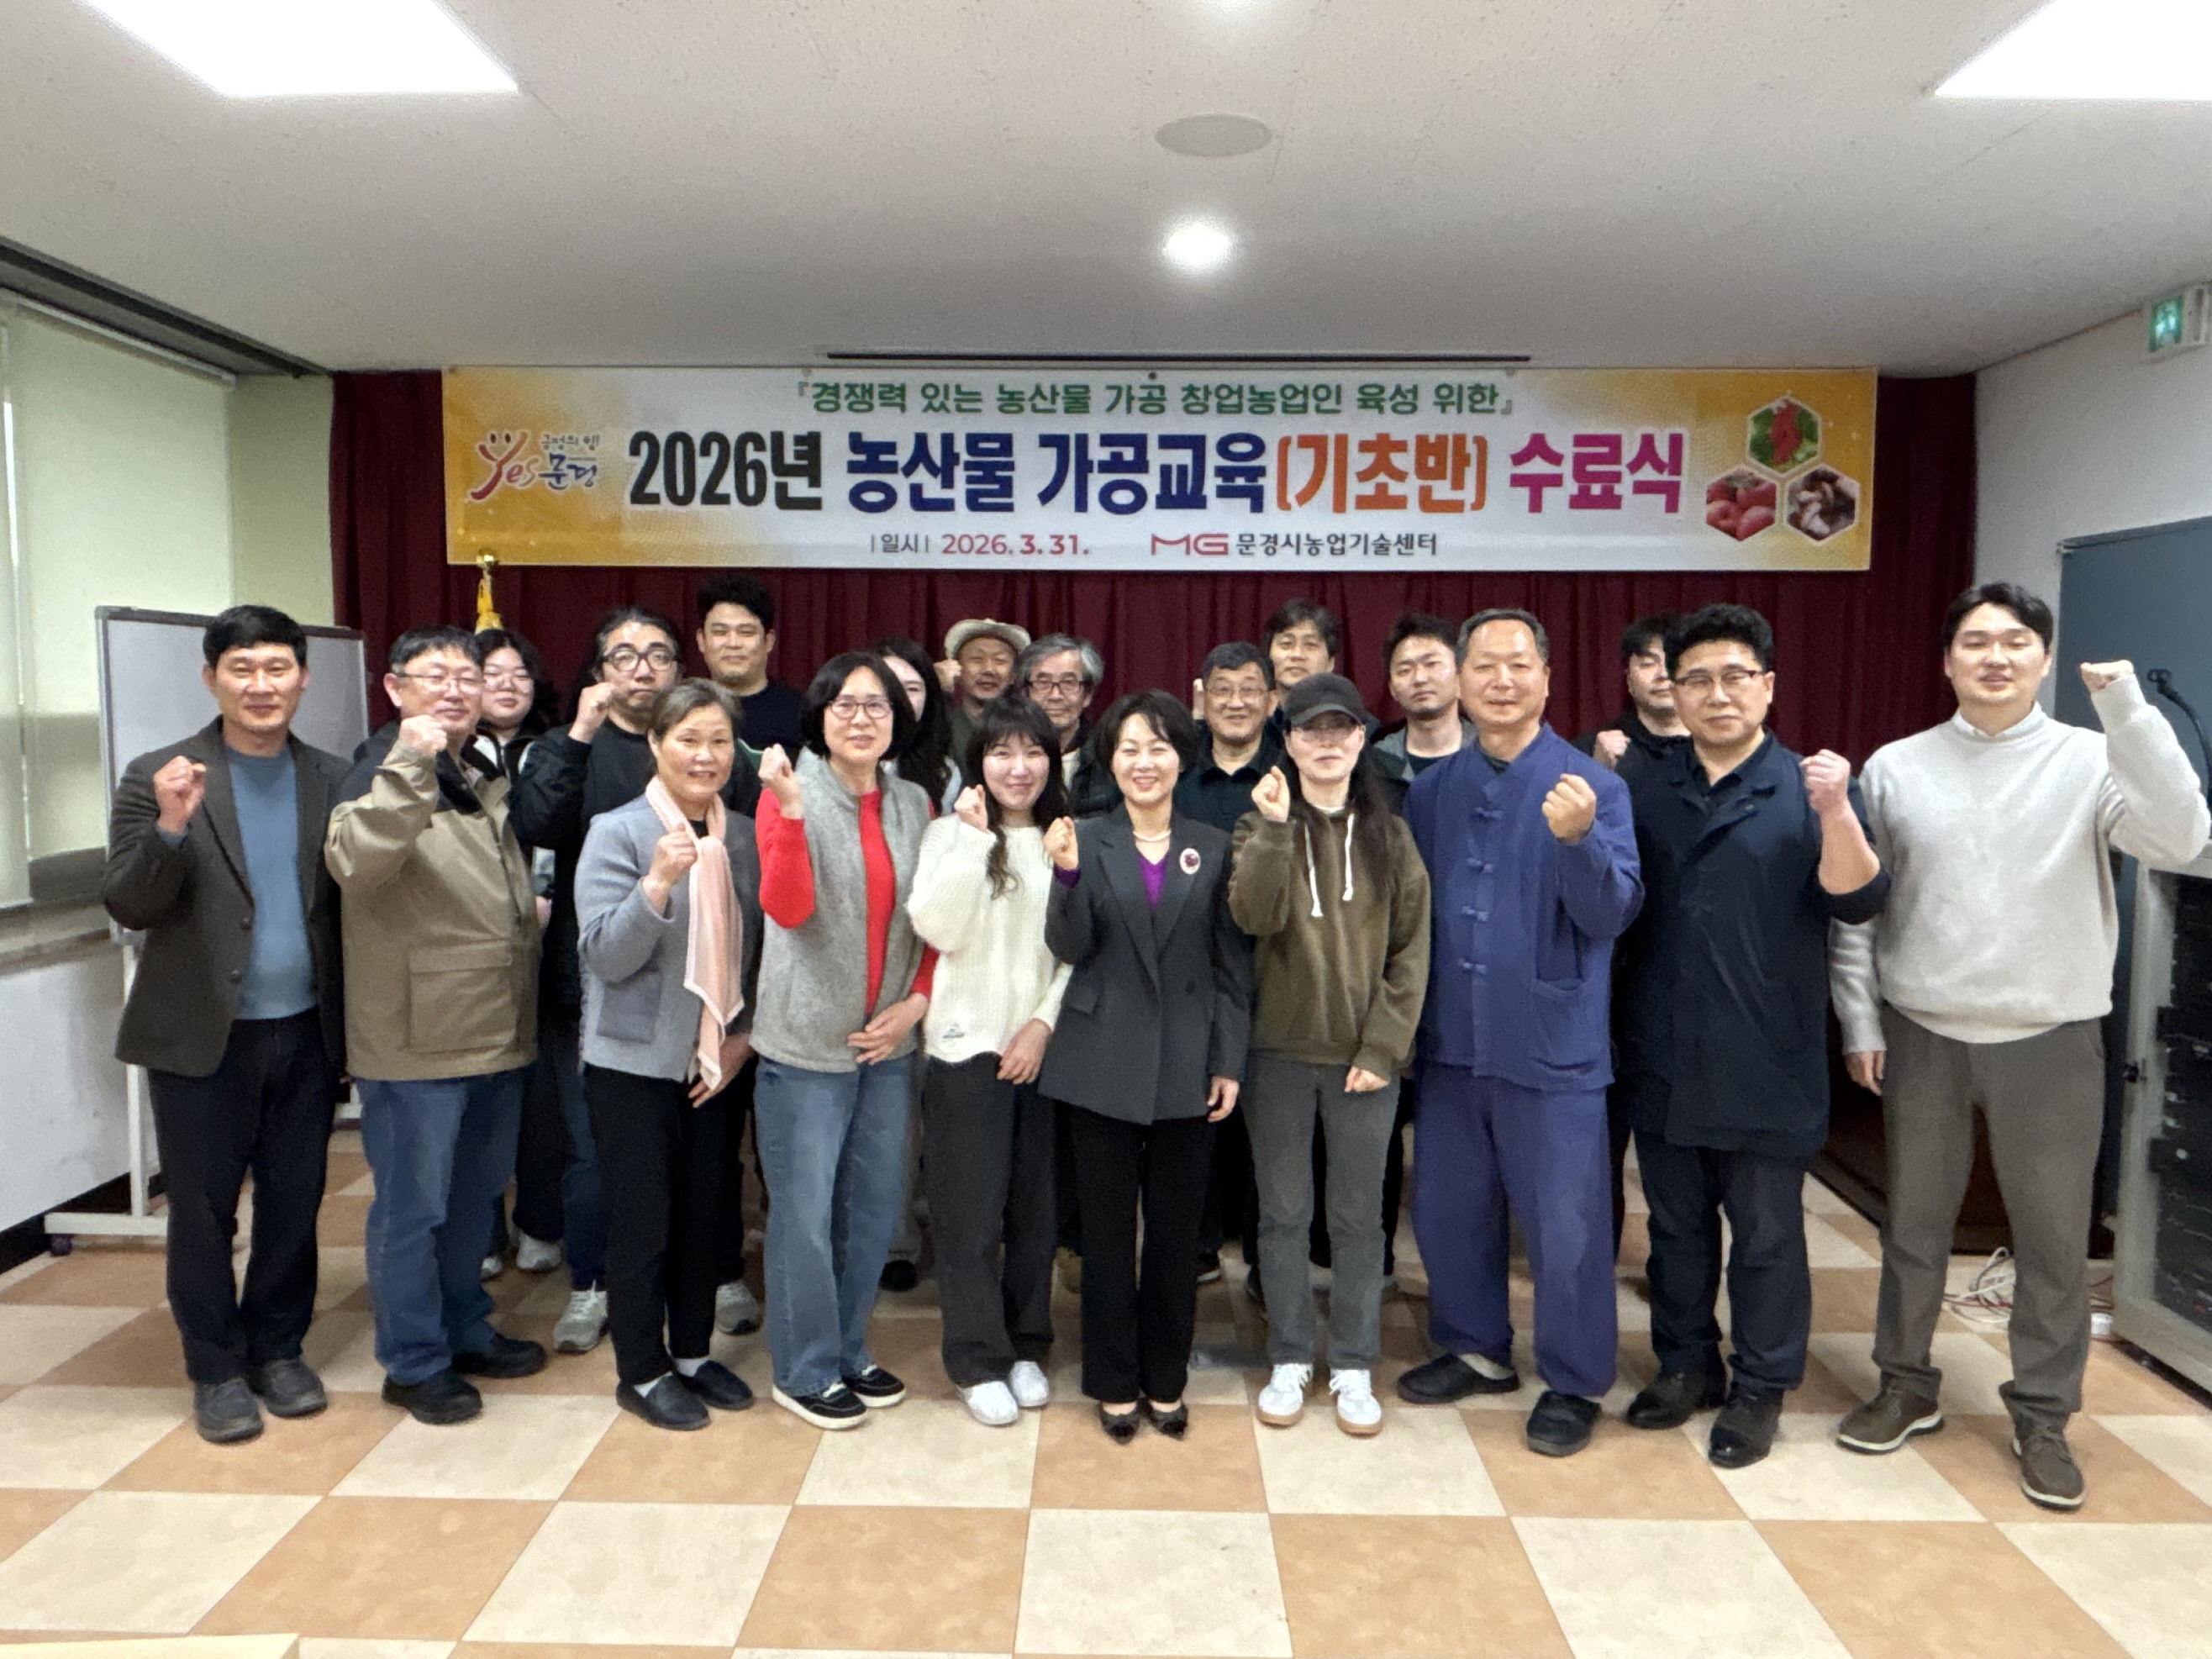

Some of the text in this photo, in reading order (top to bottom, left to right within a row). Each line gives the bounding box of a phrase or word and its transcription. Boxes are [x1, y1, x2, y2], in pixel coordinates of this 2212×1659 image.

[920, 382, 983, 416] 있는
[997, 382, 1093, 415] 농산물
[1105, 383, 1168, 415] 가공
[1181, 383, 1343, 415] 창업농업인
[1356, 383, 1419, 415] 육성
[470, 431, 540, 500] Yes
[539, 452, 598, 491] 문경
[628, 430, 824, 511] 2026년
[845, 431, 1015, 514] 농산물
[1509, 431, 1684, 514] 수료식
[1151, 532, 1438, 556] MG 문경시농업기술센터
